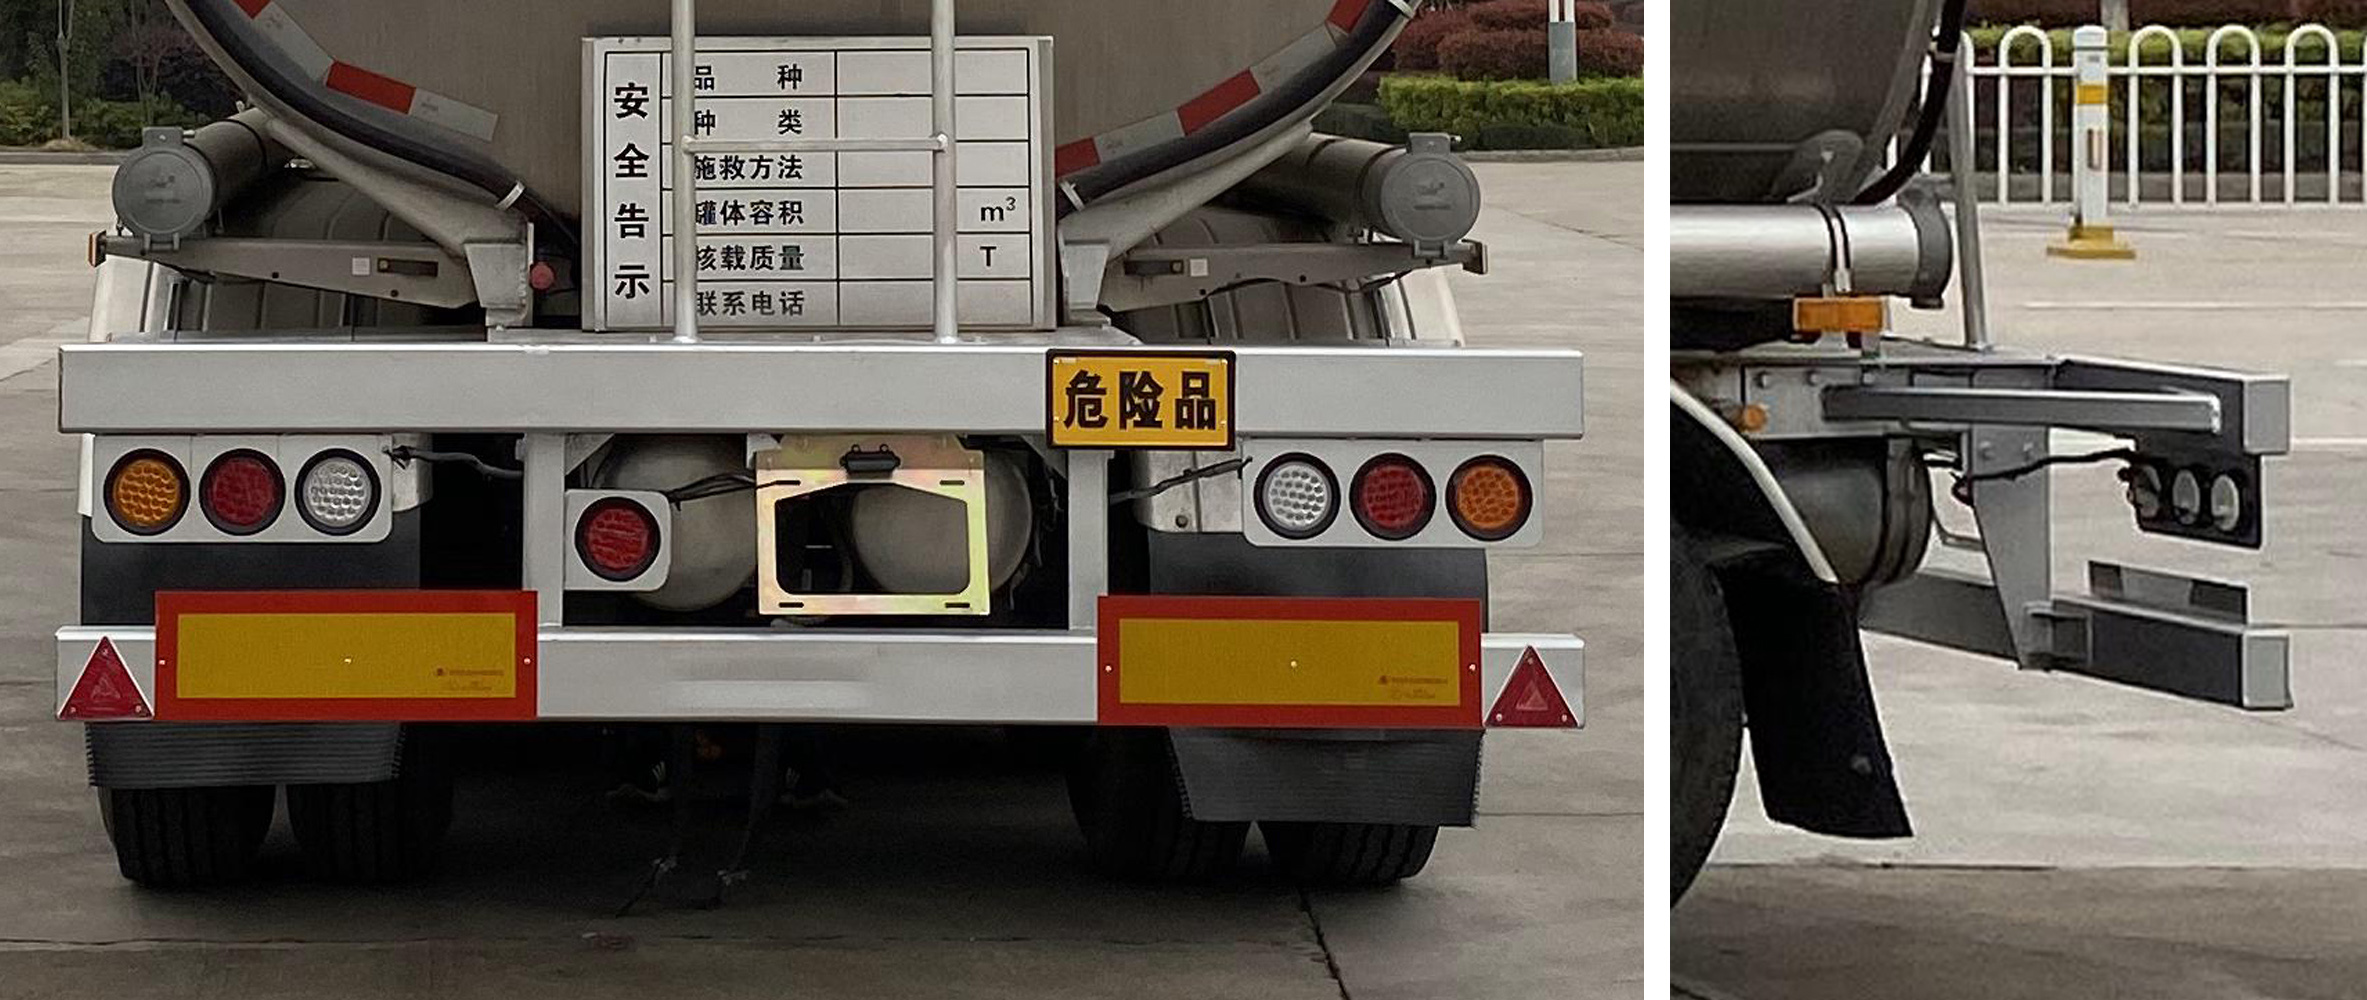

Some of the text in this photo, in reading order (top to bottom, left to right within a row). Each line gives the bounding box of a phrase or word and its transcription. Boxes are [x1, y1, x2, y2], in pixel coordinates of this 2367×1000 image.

[694, 154, 803, 181] 施救方法
[614, 82, 650, 299] 安全告示
[695, 199, 804, 226] 罐体容积
[696, 244, 804, 271] 核载质量
[979, 246, 997, 267] T
[696, 290, 804, 316] 联系电话
[1064, 369, 1216, 430] 危险品
